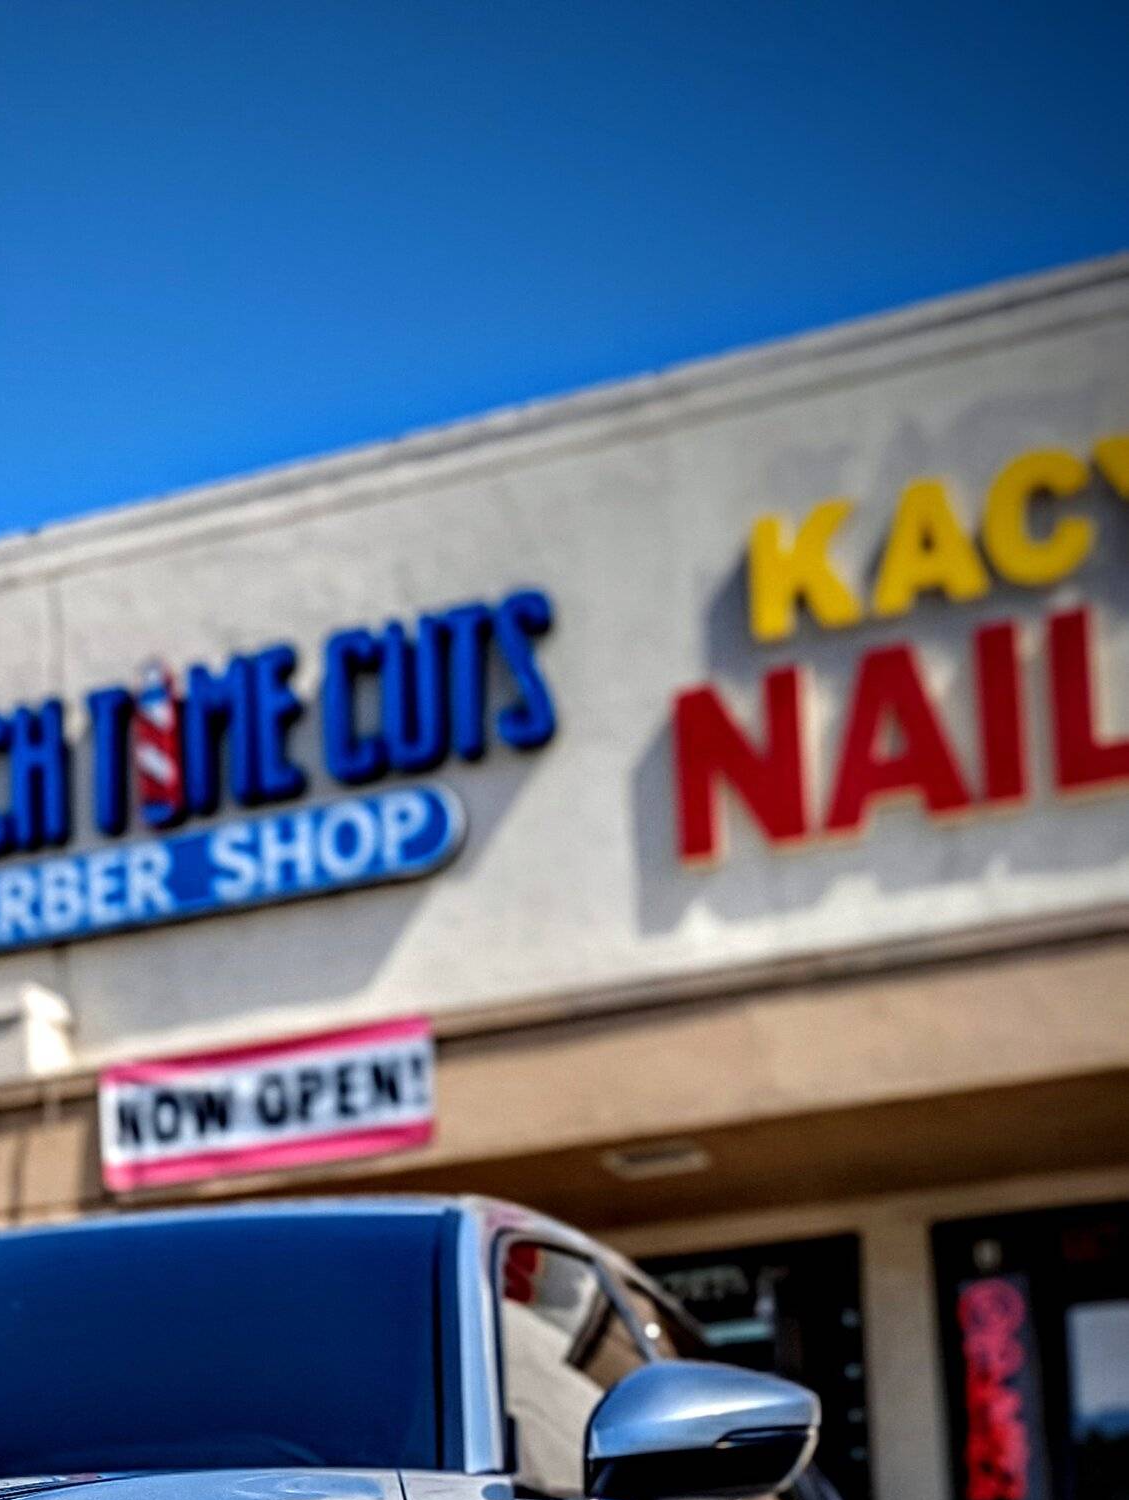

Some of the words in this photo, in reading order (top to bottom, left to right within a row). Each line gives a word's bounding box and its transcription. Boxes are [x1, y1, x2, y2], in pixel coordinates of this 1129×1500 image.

[321, 587, 559, 785] CUTS
[207, 789, 430, 902] SHOP
[118, 1088, 234, 1146] NOW
[256, 1053, 429, 1127] OPEN!
